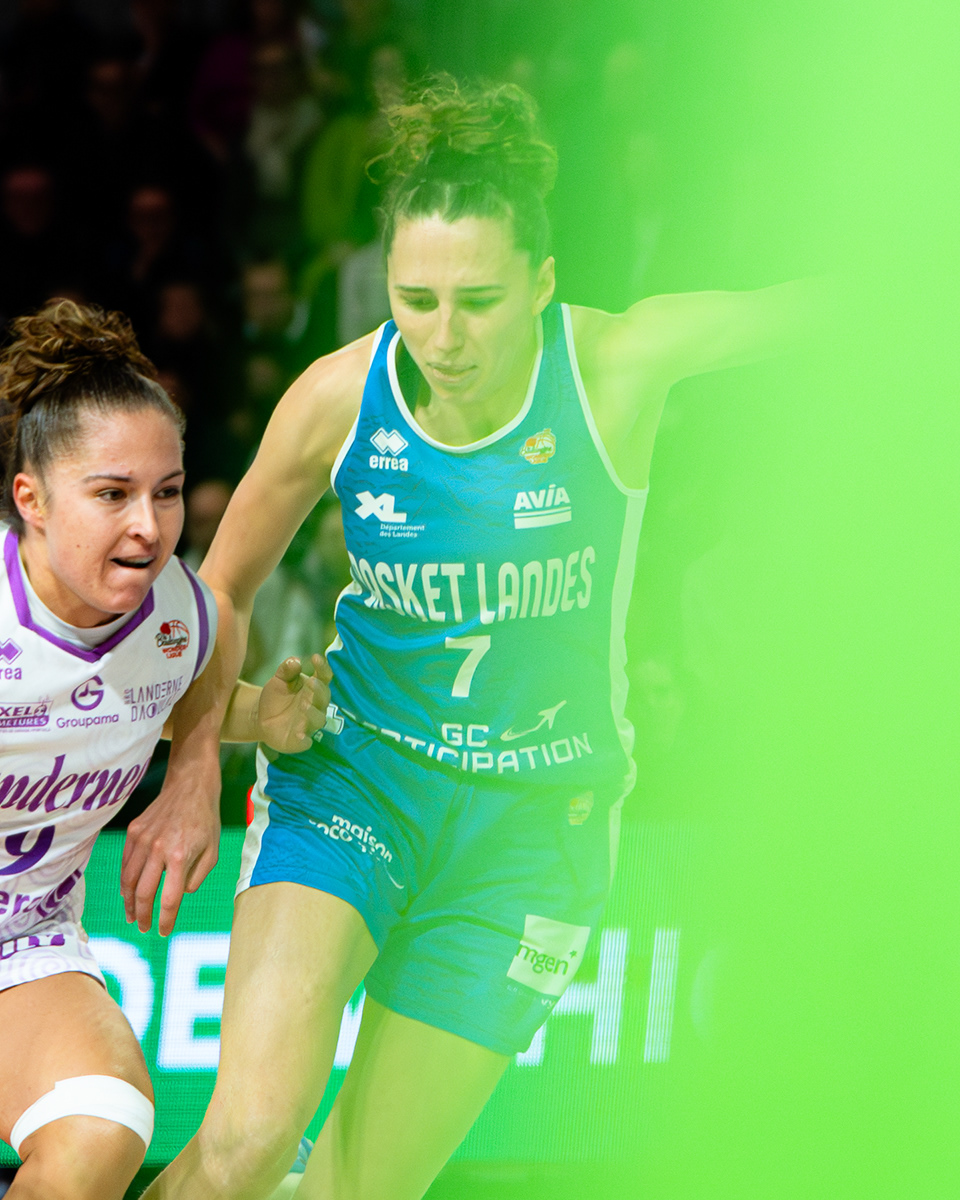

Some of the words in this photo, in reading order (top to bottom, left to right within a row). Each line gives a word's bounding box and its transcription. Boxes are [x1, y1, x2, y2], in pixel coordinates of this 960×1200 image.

[369, 455, 409, 471] errea
[354, 490, 407, 523] XL
[477, 546, 596, 624] LANDES
[445, 635, 491, 697] 7
[56, 714, 119, 728] Groupama
[442, 723, 489, 747] GC
[332, 815, 393, 863] maison
[517, 944, 569, 976] mgen
